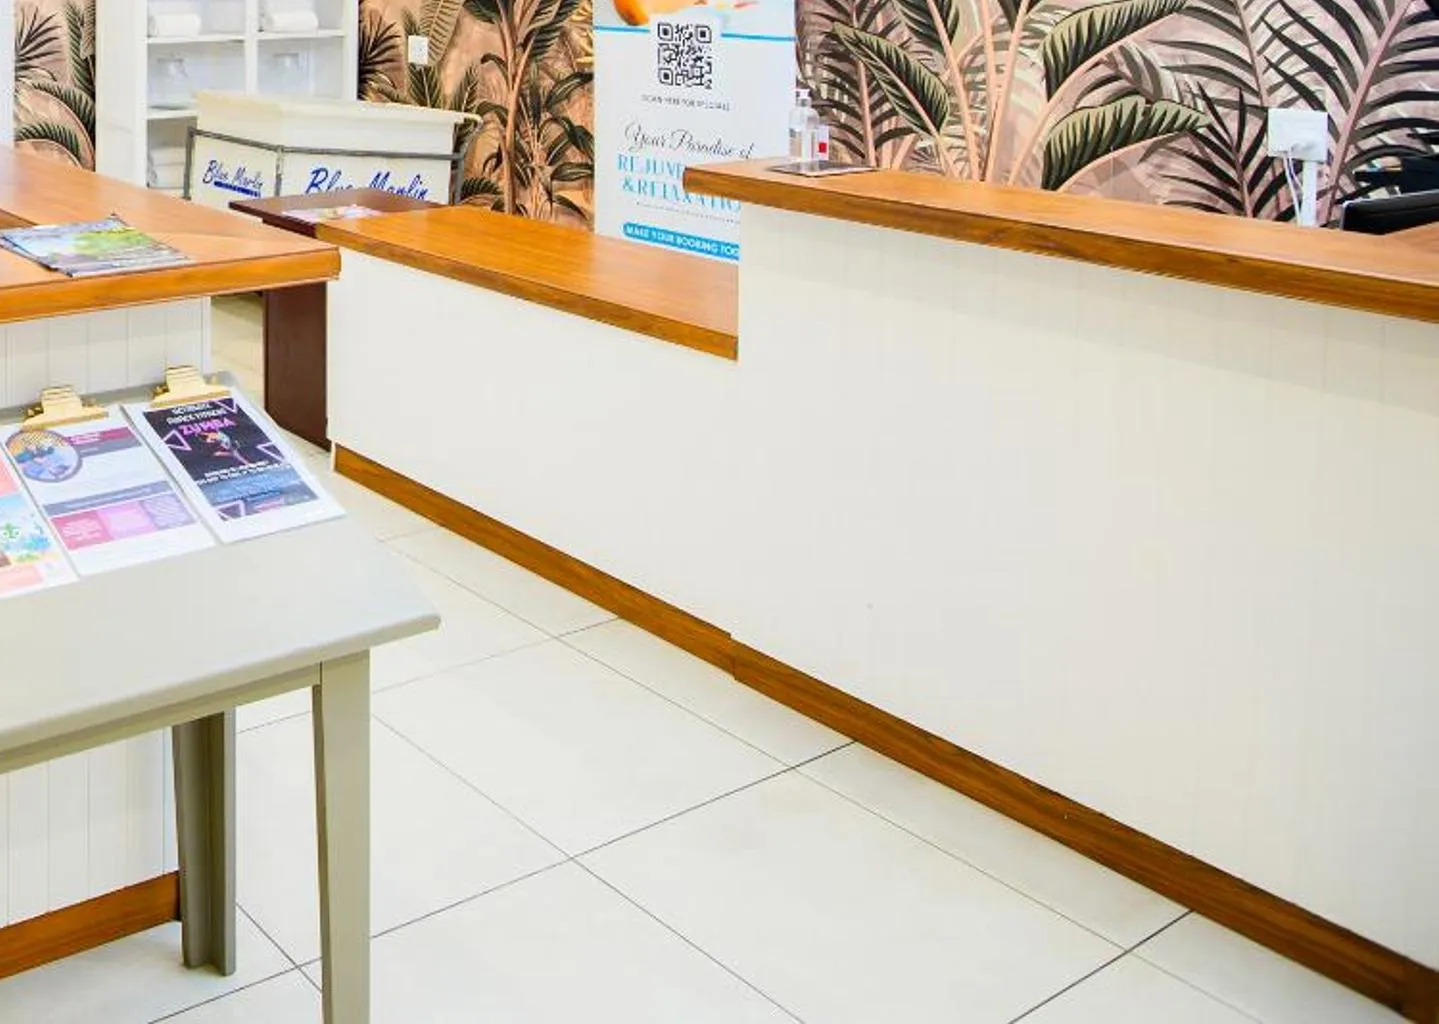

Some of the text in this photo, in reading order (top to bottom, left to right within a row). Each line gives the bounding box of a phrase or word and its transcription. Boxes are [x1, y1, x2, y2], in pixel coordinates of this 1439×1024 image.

[624, 122, 667, 152] Your
[720, 243, 740, 257] TOD
[178, 418, 236, 436] ZUMBA
